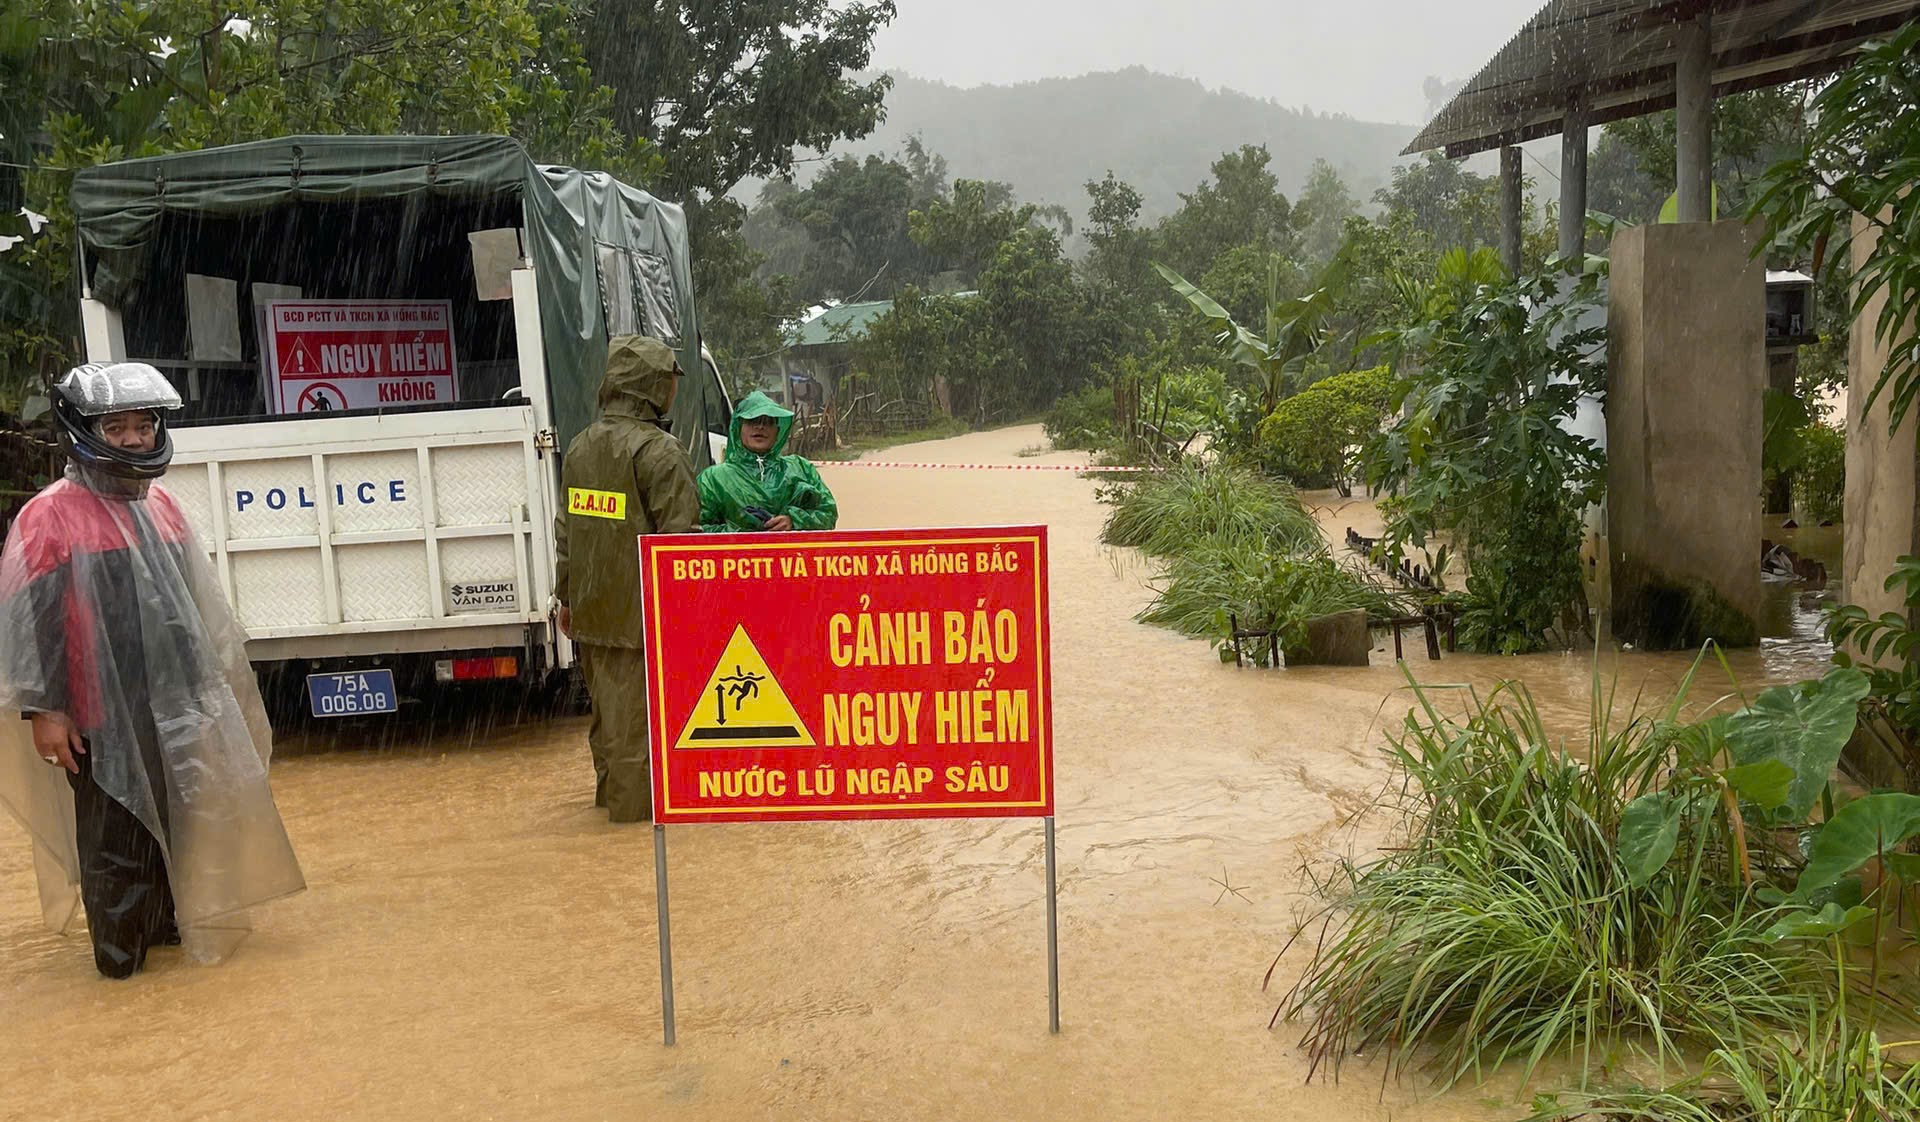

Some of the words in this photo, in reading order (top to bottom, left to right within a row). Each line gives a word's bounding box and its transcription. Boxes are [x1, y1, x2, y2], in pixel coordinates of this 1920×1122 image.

[307, 311, 331, 322] PCTT
[320, 344, 382, 374] NGUY
[390, 331, 446, 372] HIỂM
[378, 378, 436, 402] KHÔNG
[236, 480, 406, 512] POLICE
[673, 558, 716, 581] BCĐ
[723, 556, 774, 580] PCTT
[780, 552, 808, 578] VÀ
[813, 555, 869, 577] TKCN
[875, 550, 904, 577] XÃ
[910, 545, 969, 574] HỒNG
[975, 543, 1019, 573] BẮC
[465, 583, 514, 594] SUZUKI
[829, 594, 931, 668] CẢNH
[943, 598, 1019, 665] BÁO
[331, 675, 370, 693] 75A
[321, 692, 387, 714] 006.08
[823, 692, 922, 747] NGUY
[936, 667, 1030, 745] HIỂM
[699, 765, 786, 798] NƯỚC
[798, 764, 836, 797] LŨ
[846, 762, 934, 800] NGẬP
[945, 760, 1010, 794] SÂU
